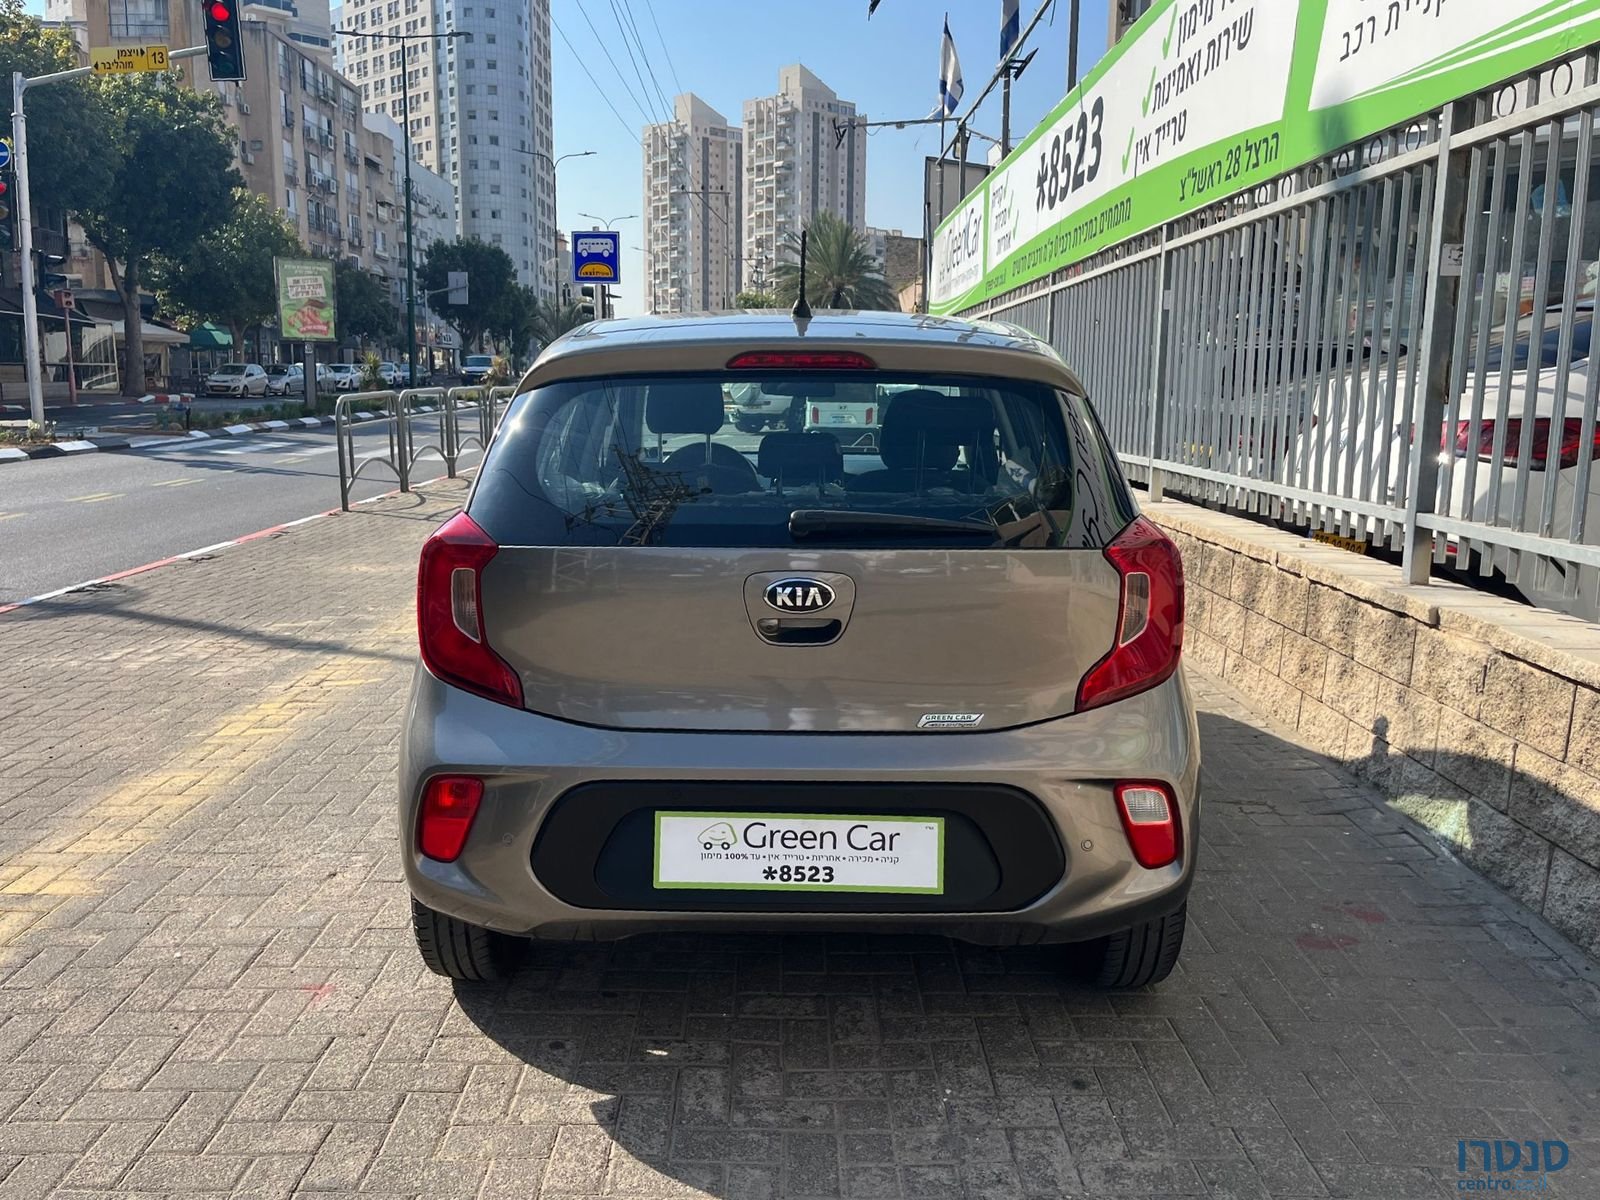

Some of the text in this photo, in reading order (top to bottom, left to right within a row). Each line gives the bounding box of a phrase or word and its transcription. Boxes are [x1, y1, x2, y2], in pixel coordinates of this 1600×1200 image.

[1339, 16, 1376, 62] רכב
[117, 48, 139, 60] ויצמן
[151, 51, 165, 65] 13
[1152, 7, 1254, 114] שירות ואמינות
[100, 59, 134, 70] מוהליבר
[1134, 109, 1187, 178] טרייד אין
[1179, 132, 1279, 202] הרצל 28 ראשל"צ
[1099, 197, 1131, 234] מתמחים
[776, 586, 824, 606] KIA
[743, 821, 900, 851] Green Car
[701, 852, 722, 861] מימון
[768, 853, 780, 862] אין
[811, 854, 841, 862] אחריות
[848, 855, 874, 863] מכירה
[880, 856, 899, 865] קניה
